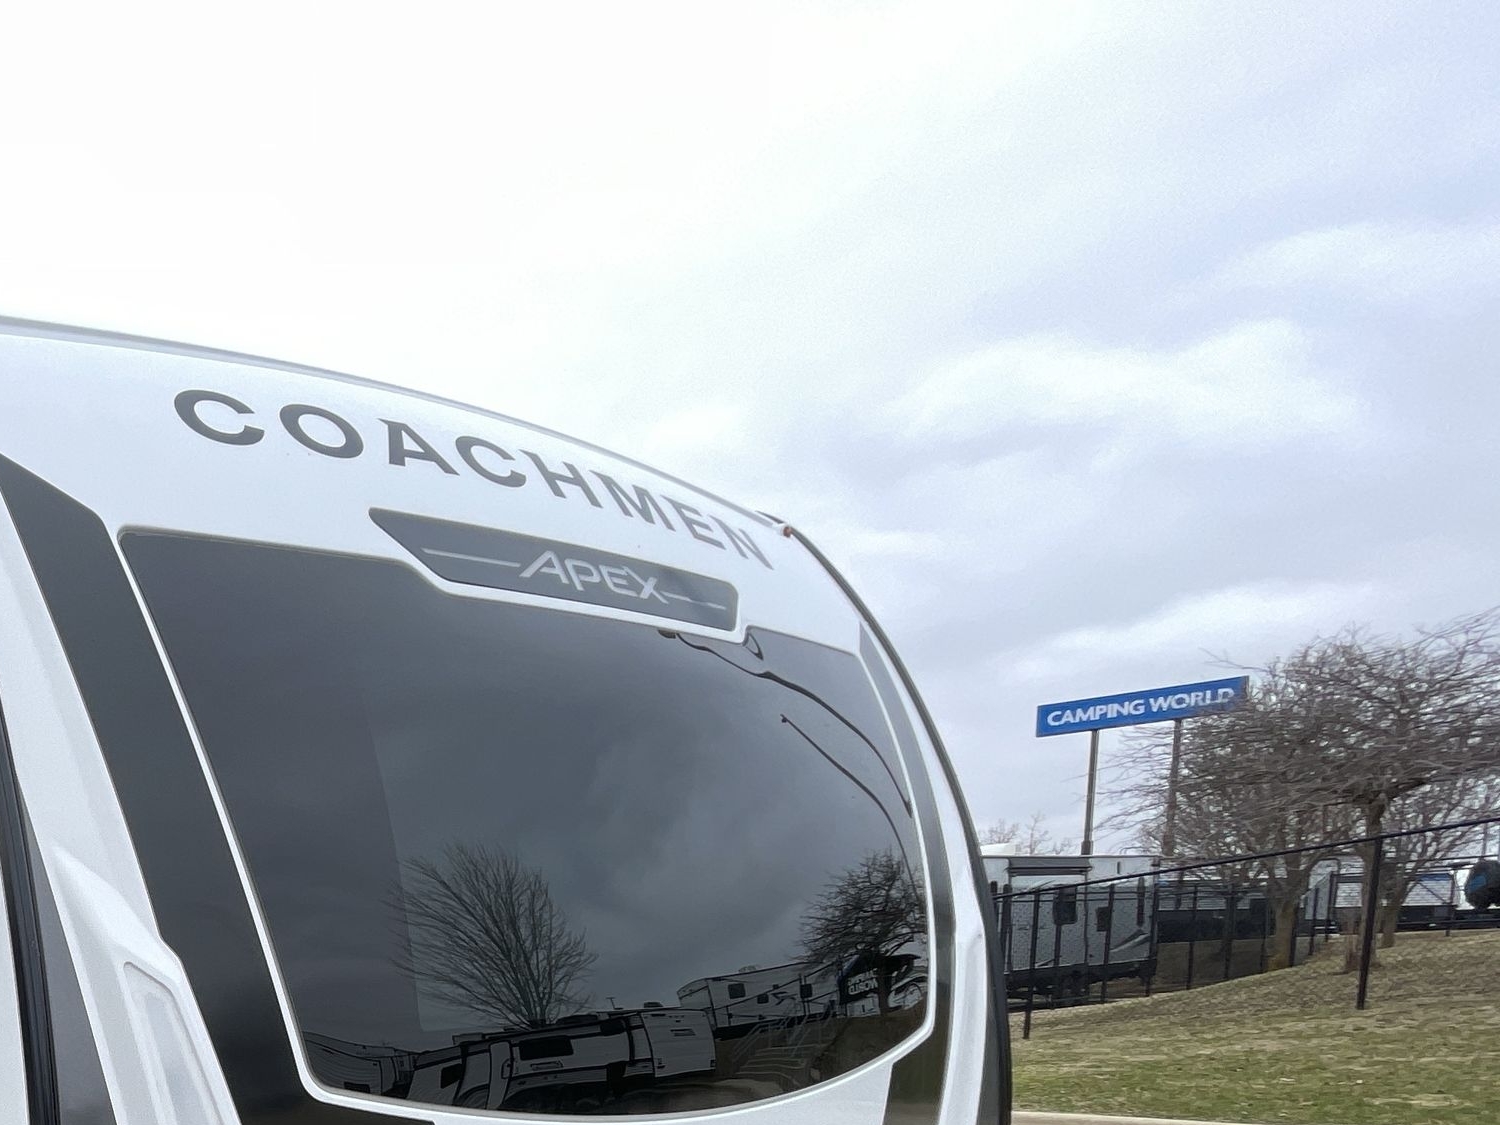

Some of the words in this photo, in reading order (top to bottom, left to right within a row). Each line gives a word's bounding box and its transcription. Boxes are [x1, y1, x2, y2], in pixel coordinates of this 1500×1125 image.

[173, 388, 776, 571] COACHMEN
[519, 549, 669, 605] APEX
[1046, 698, 1146, 727] CAMPING
[1148, 687, 1235, 713] WORLD
